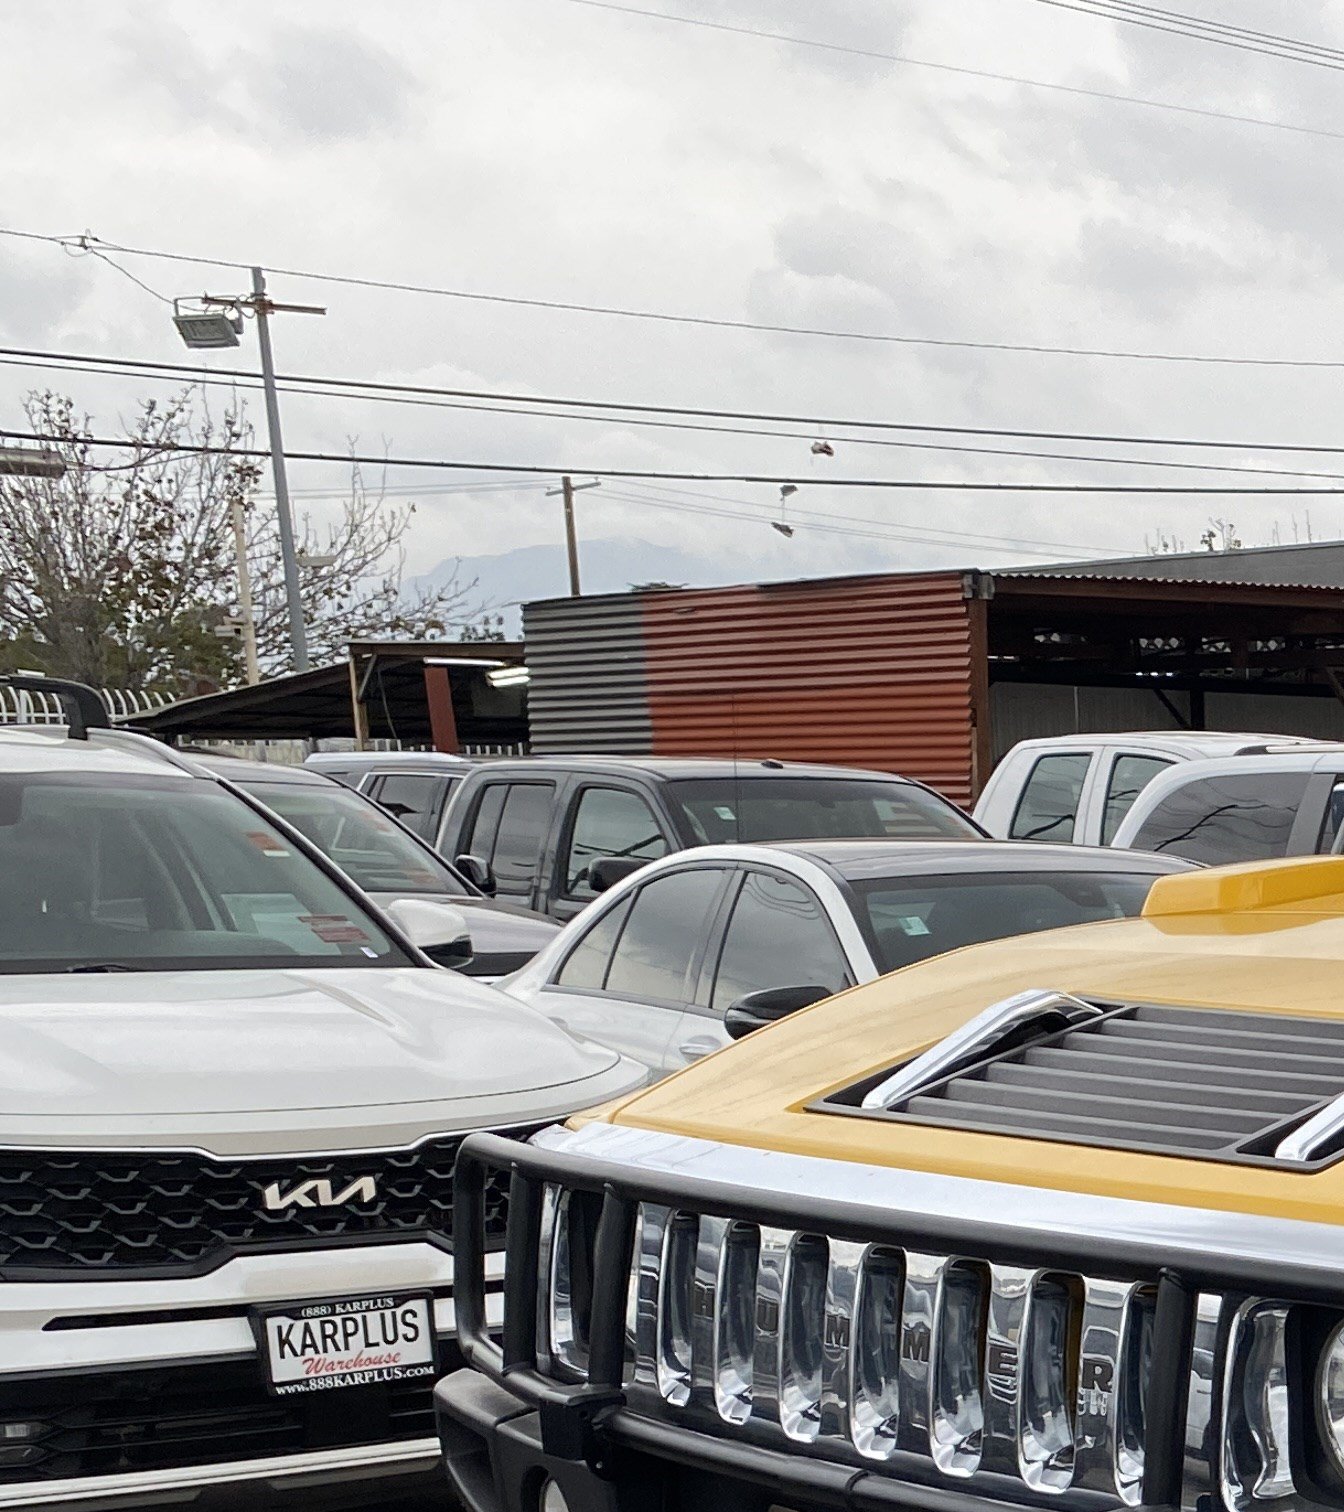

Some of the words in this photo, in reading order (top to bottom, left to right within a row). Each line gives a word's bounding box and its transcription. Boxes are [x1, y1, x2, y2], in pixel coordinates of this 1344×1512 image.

[263, 1175, 377, 1210] KIA
[301, 1305, 332, 1318] (888)
[335, 1298, 394, 1314] KARPLUS
[276, 1308, 420, 1360] KARPLUS
[302, 1349, 401, 1375] Warehouse
